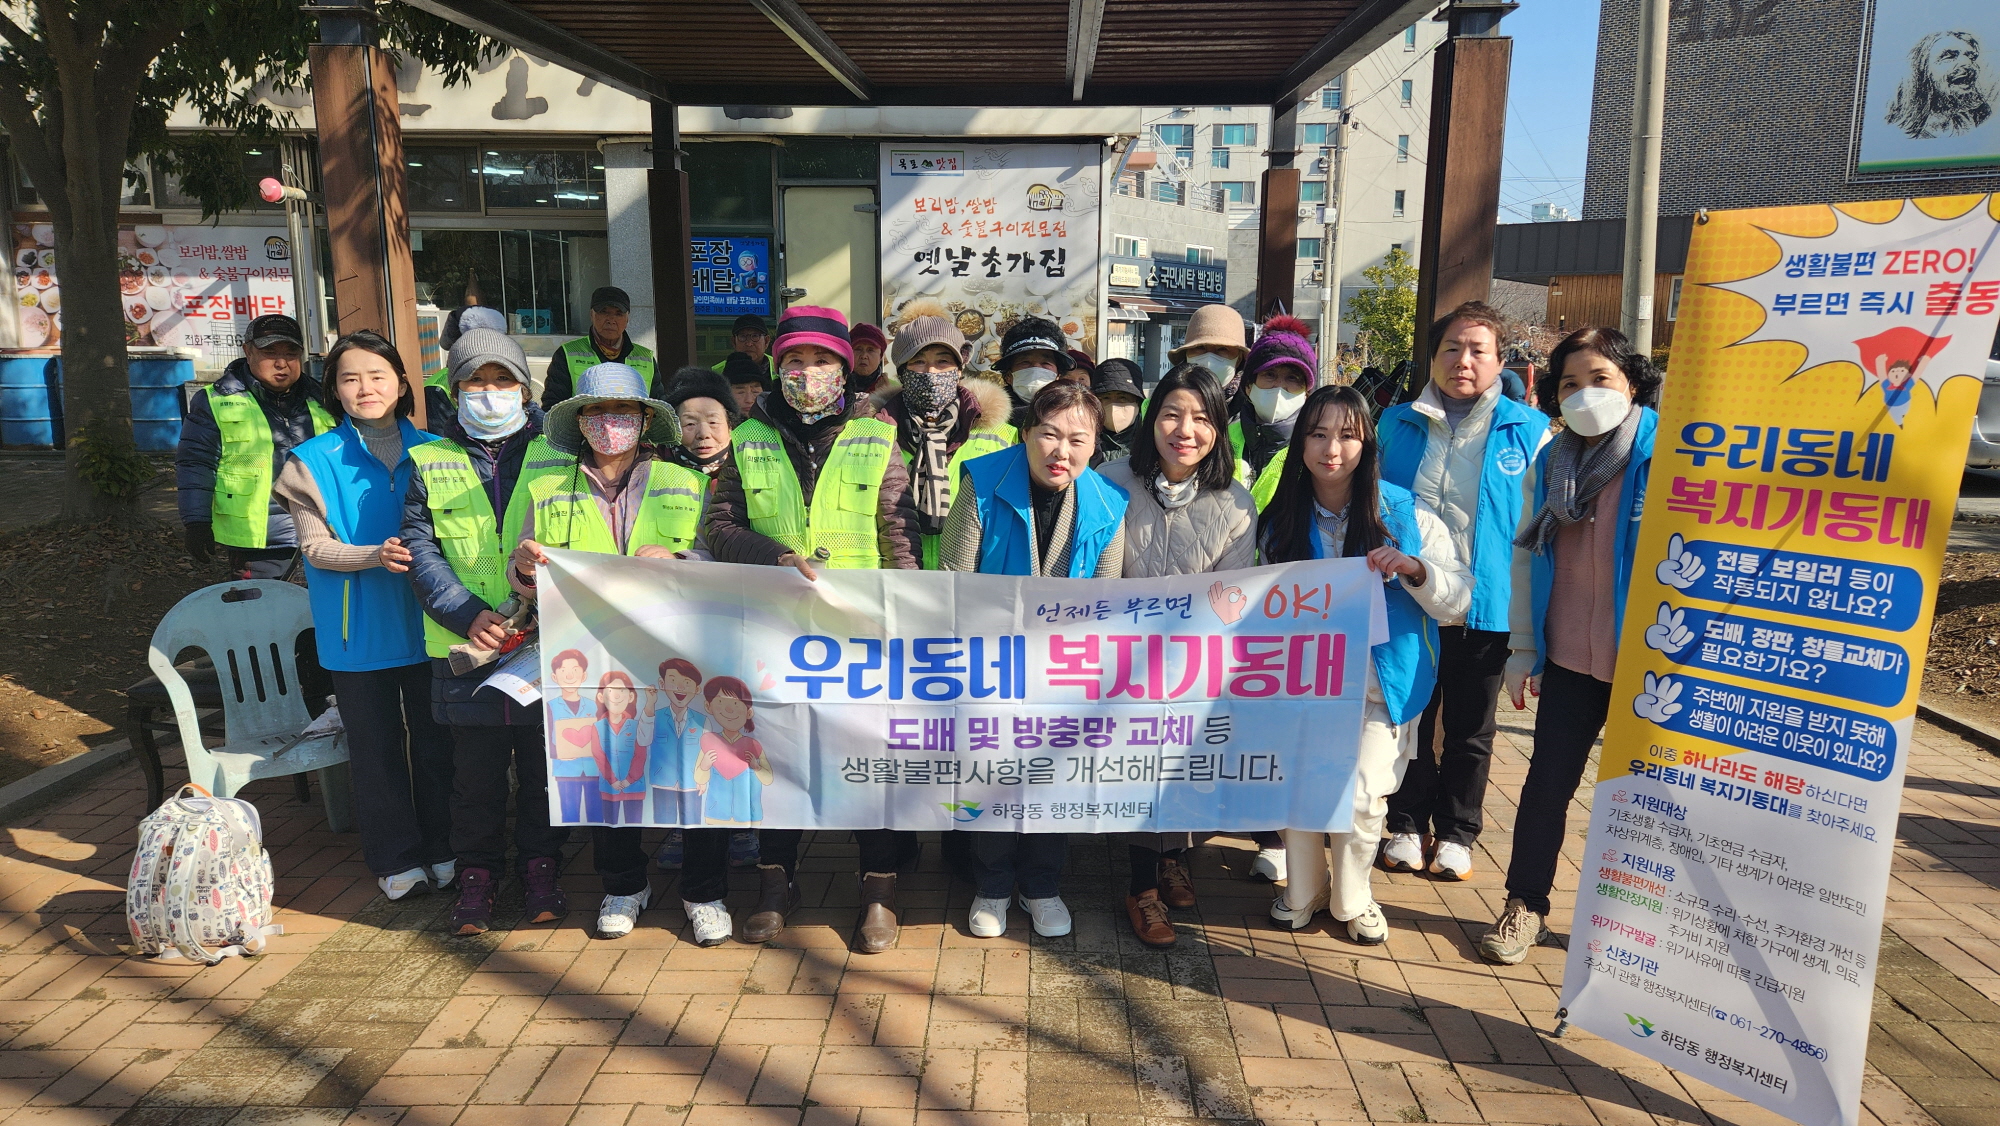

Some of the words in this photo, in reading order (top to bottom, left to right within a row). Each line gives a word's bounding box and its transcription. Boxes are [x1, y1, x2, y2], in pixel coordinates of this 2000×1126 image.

[936, 157, 957, 170] 맛집
[941, 222, 952, 235] &
[958, 219, 1067, 238] 숯불구이전문점
[691, 240, 733, 266] 포장
[914, 246, 1066, 277] 옛날초가집
[1785, 251, 1877, 278] 생활불편
[1882, 248, 1977, 276] ZERO!
[199, 267, 210, 279] &
[1160, 266, 1195, 290] 국민세탁
[1197, 269, 1224, 293] 빨래방
[183, 294, 286, 321] 포장배달
[1772, 292, 1850, 316] 부르면
[1859, 291, 1914, 315] 즉시
[1925, 280, 2000, 316] 출동
[185, 334, 222, 347] 전화주문
[226, 334, 246, 347] 06
[1675, 422, 1894, 482] 우리동네
[1666, 476, 1931, 549] 복지기동대
[1772, 557, 1841, 586] 보일러
[1849, 568, 1894, 595] 등이
[1036, 600, 1113, 624] 언제든
[1123, 593, 1194, 625] 부르면
[1263, 582, 1333, 621] OK!
[1712, 573, 1800, 605] 작동되지
[1808, 588, 1893, 620] 않나요?
[1701, 646, 1827, 684] 필요한가요?
[1703, 619, 1745, 645] 도배,
[1751, 627, 1795, 656] 장판,
[1801, 636, 1904, 675] 창틀교체가
[785, 634, 1026, 701] 우리동네
[1045, 633, 1347, 700] 복지기동대
[887, 717, 956, 752] 도배
[968, 716, 1000, 751] 및
[1012, 715, 1117, 749] 방충망
[1126, 714, 1194, 747] 교체
[1204, 715, 1231, 746] 등
[1692, 686, 1745, 715] 주변에
[1749, 697, 1805, 728] 지원을
[1808, 711, 1846, 738] 받지
[1849, 720, 1887, 749] 못해
[1688, 709, 1731, 737] 생활이
[1733, 720, 1779, 748] 어려운
[1782, 730, 1831, 760] 이웃이
[1833, 743, 1887, 775] 있나요?
[841, 756, 1056, 786] 생활불편사항을
[1066, 753, 1284, 785] 개선해드립니다.
[1649, 744, 1678, 763] 이중
[1683, 749, 1758, 784] 하나라도
[992, 802, 1044, 820] 하당동
[1051, 801, 1154, 820] 행정복지센터
[1628, 758, 1695, 791] 우리동네
[1699, 773, 1803, 820] 복지기동대를
[1806, 808, 1878, 844] 찾아주세요.
[1631, 792, 1688, 821] 지원대상
[1608, 807, 1656, 830] 기초생활
[1657, 820, 1694, 843] 수급자,
[1696, 832, 1745, 858] 기초연금
[1747, 847, 1788, 871] 수급자,
[1605, 824, 1665, 852] 차상위계층,
[1668, 841, 1705, 864] 장애인,
[1708, 854, 1734, 875] 기타
[1735, 861, 1774, 887] 생계가
[1777, 874, 1816, 899] 어려운
[1818, 887, 1868, 918] 일반도민
[1621, 852, 1676, 883] 지원내용
[1595, 881, 1663, 915] 생활안정지원
[1671, 907, 1730, 940] 위기상황에
[1733, 928, 1758, 950] 처한
[1760, 937, 1799, 962] 가구에
[1598, 865, 1667, 898] 생활불편개선
[1674, 890, 1709, 912] 소규모
[1773, 922, 1826, 953] 주거환경
[1828, 941, 1853, 963] 개선
[1855, 953, 1867, 970] 등
[1590, 914, 1657, 948] 위기가구발굴
[1665, 940, 1724, 972] 위기사유에
[1726, 963, 1751, 984] 따른
[1753, 973, 1806, 1003] 긴급지원
[1667, 924, 1702, 946] 주거비
[1705, 935, 1730, 957] 지원
[1583, 955, 1617, 979] 주소지
[1618, 966, 1641, 988] 관할
[1605, 944, 1659, 977] 신청기관
[1660, 1028, 1701, 1058] 하당동
[1705, 1046, 1788, 1095] 행정복지센터
